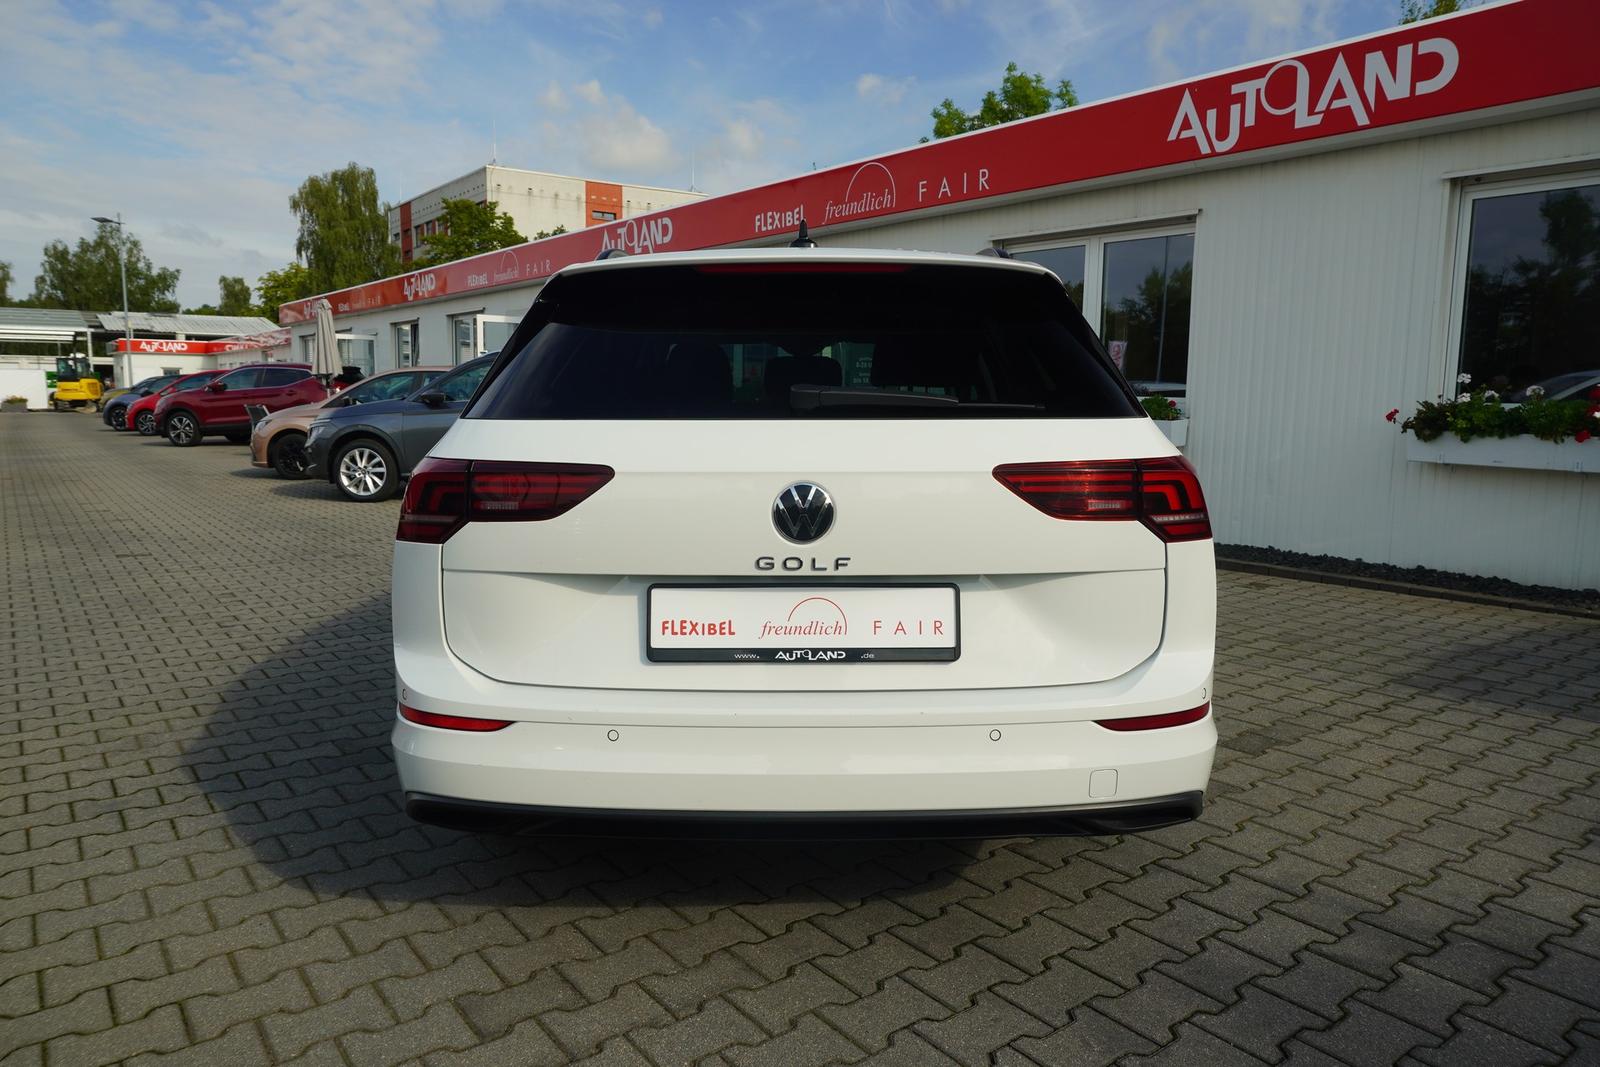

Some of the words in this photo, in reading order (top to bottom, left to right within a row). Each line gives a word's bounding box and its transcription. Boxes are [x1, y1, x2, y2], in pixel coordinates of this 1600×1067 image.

[1167, 37, 1459, 154] AUTOLAND
[822, 188, 892, 224] freundlich
[918, 168, 990, 202] FAIR
[755, 557, 851, 571] GOLF
[661, 619, 735, 636] FLEXIBEL
[758, 619, 843, 639] freundlich
[873, 620, 943, 635] FAIR
[775, 650, 846, 661] AUTOLAND
